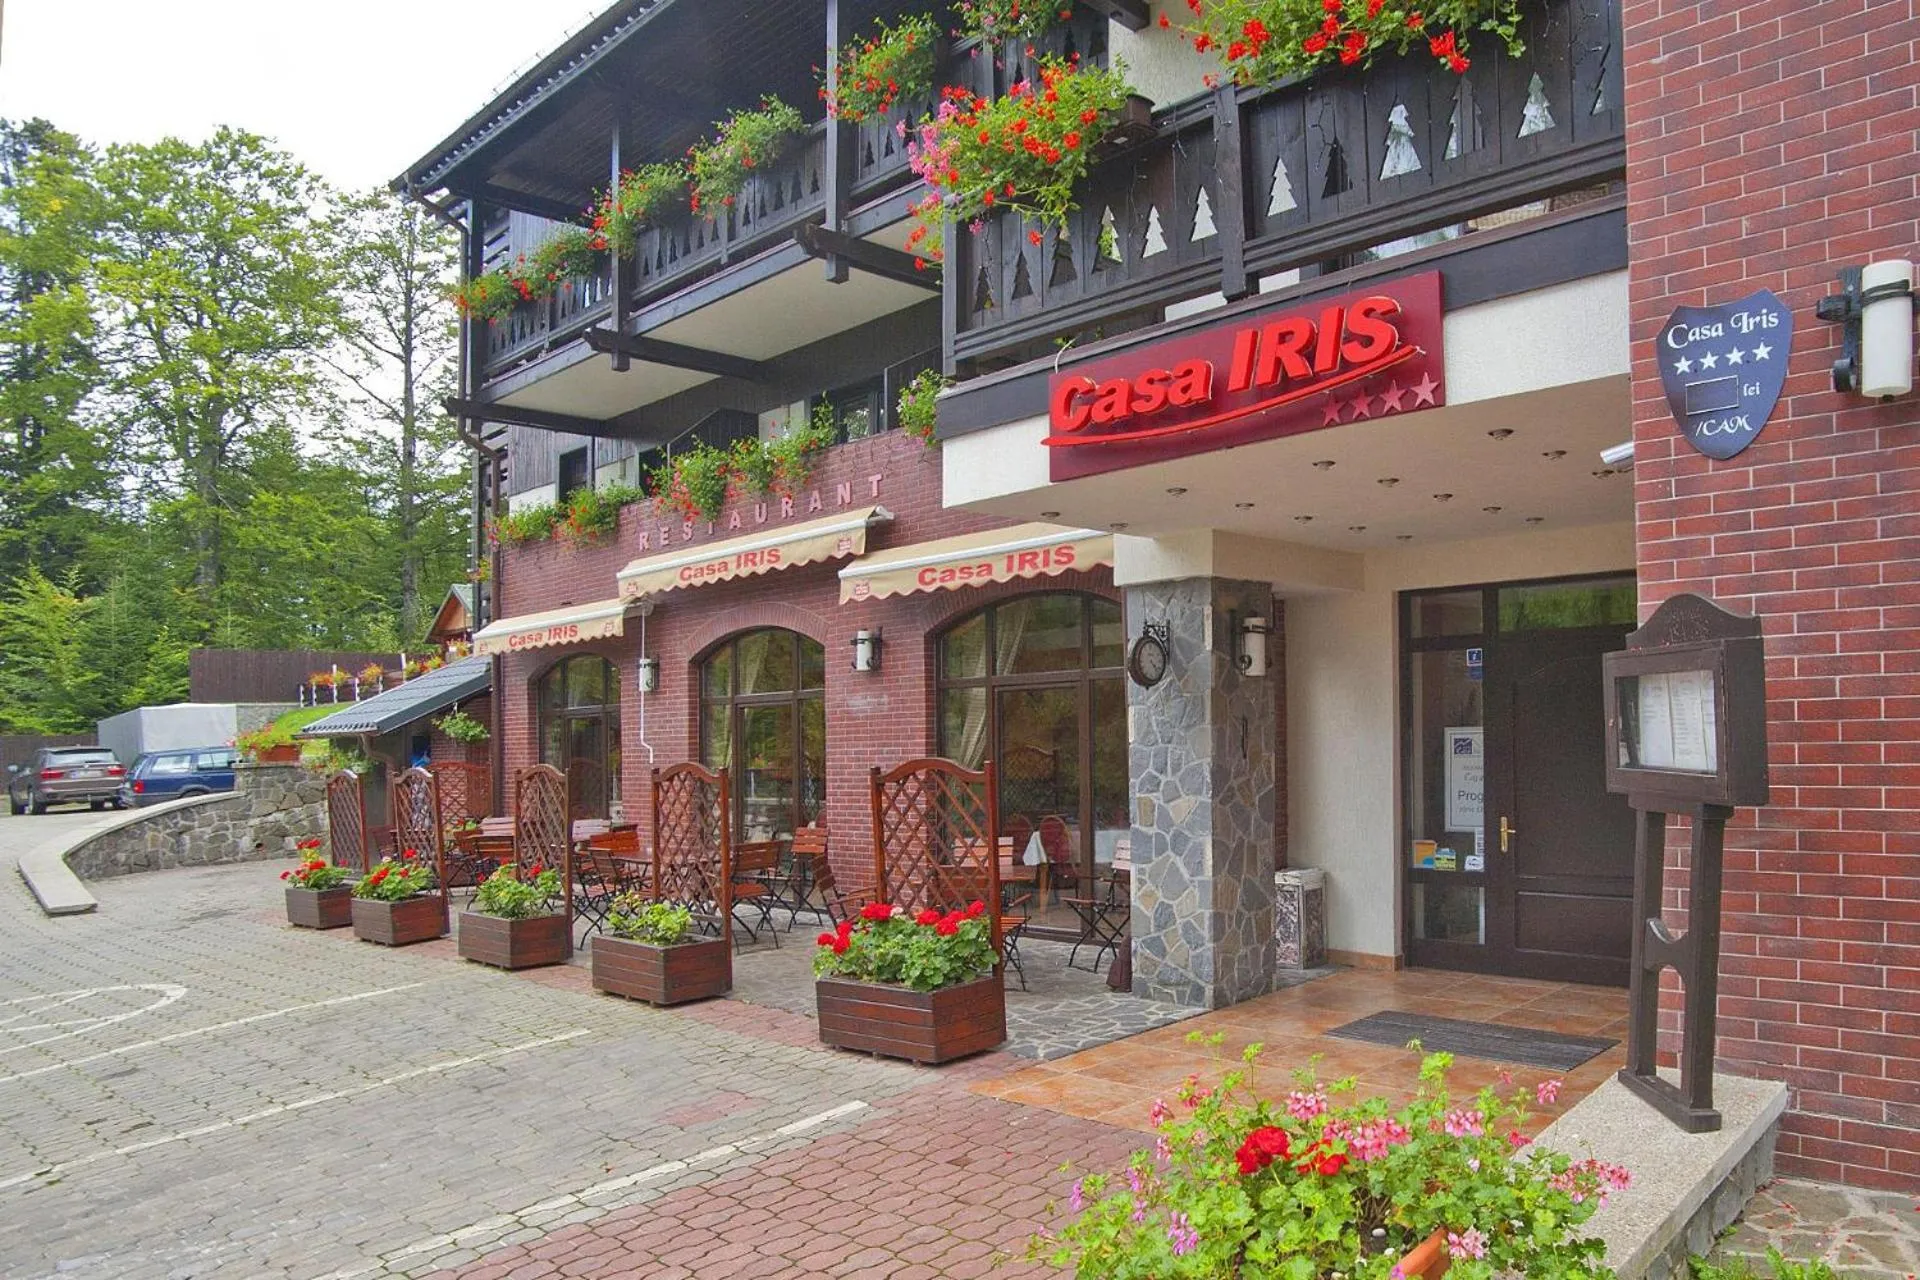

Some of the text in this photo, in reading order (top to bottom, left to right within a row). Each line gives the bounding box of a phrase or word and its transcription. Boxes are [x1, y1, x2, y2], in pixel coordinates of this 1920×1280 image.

[1667, 308, 1780, 349] Casa Iris
[1050, 296, 1402, 433] Casa IRIS
[678, 547, 781, 582] Casa IRIS
[917, 544, 1076, 587] Casa IRIS
[508, 624, 579, 648] Casa IRIS
